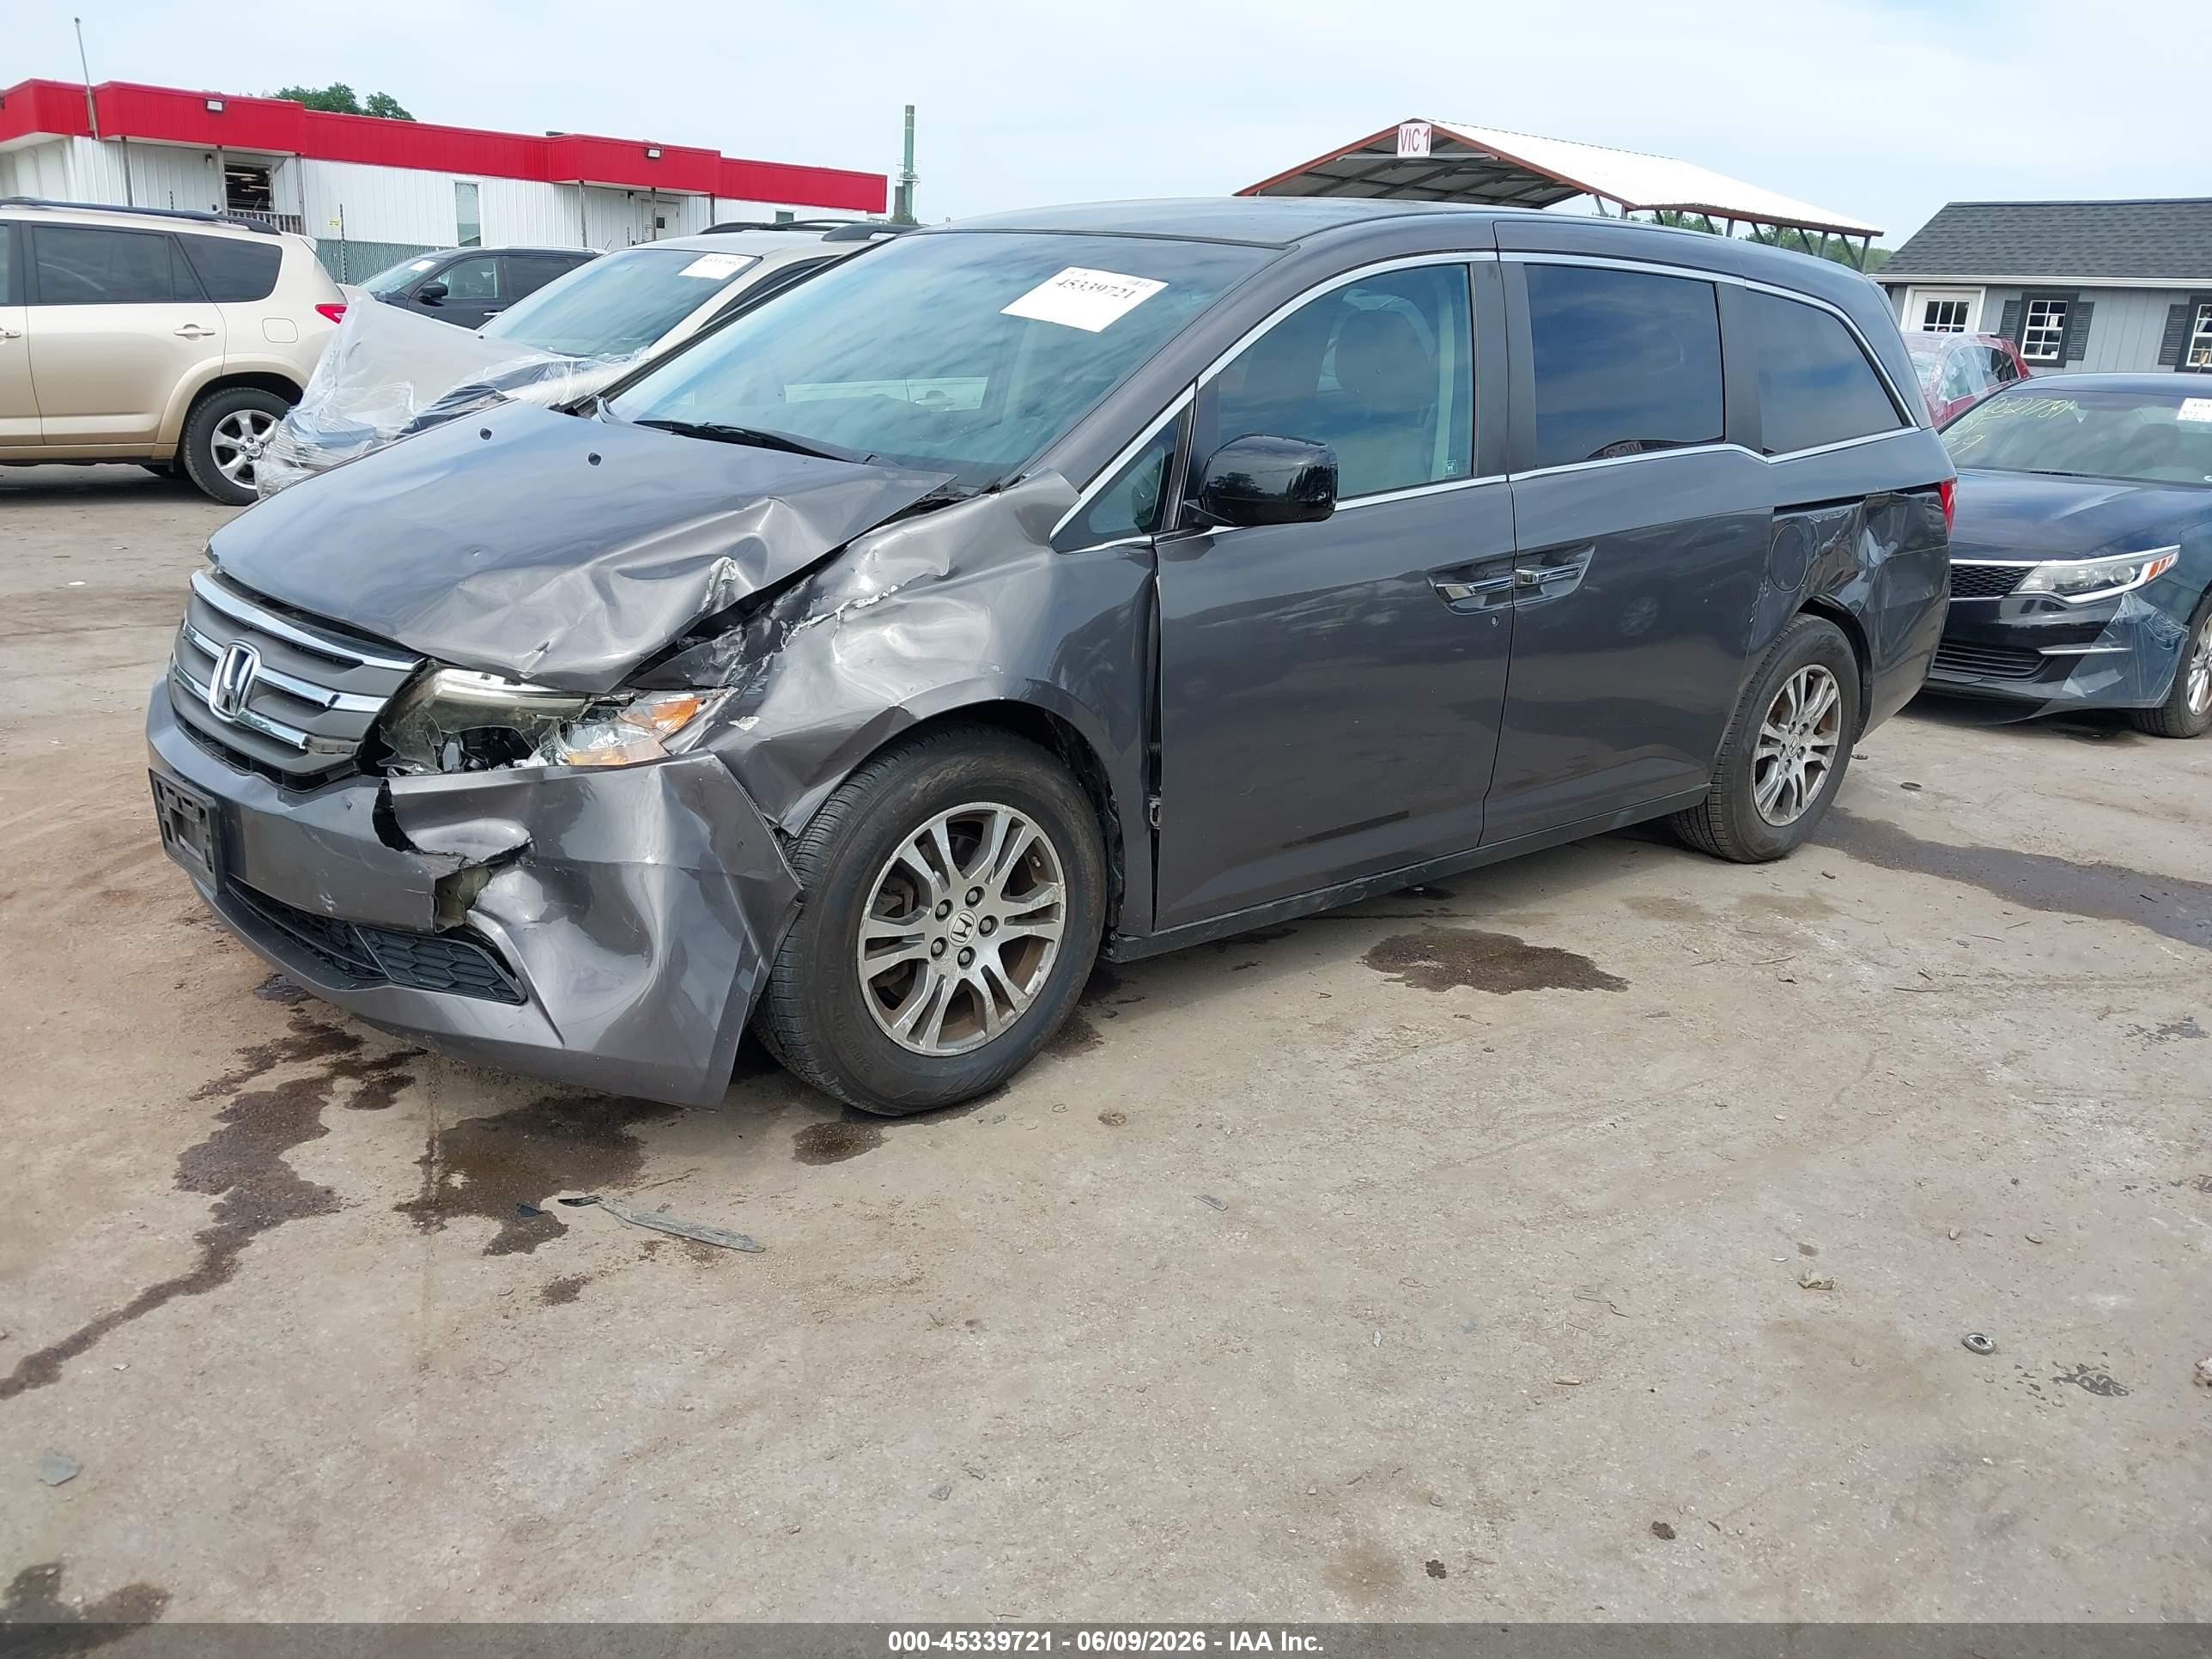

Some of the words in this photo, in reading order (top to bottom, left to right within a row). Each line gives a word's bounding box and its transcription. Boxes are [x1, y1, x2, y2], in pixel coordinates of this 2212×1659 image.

[1400, 128, 1419, 152] VIC
[1423, 127, 1430, 151] 1
[1055, 278, 1137, 300] 45339721
